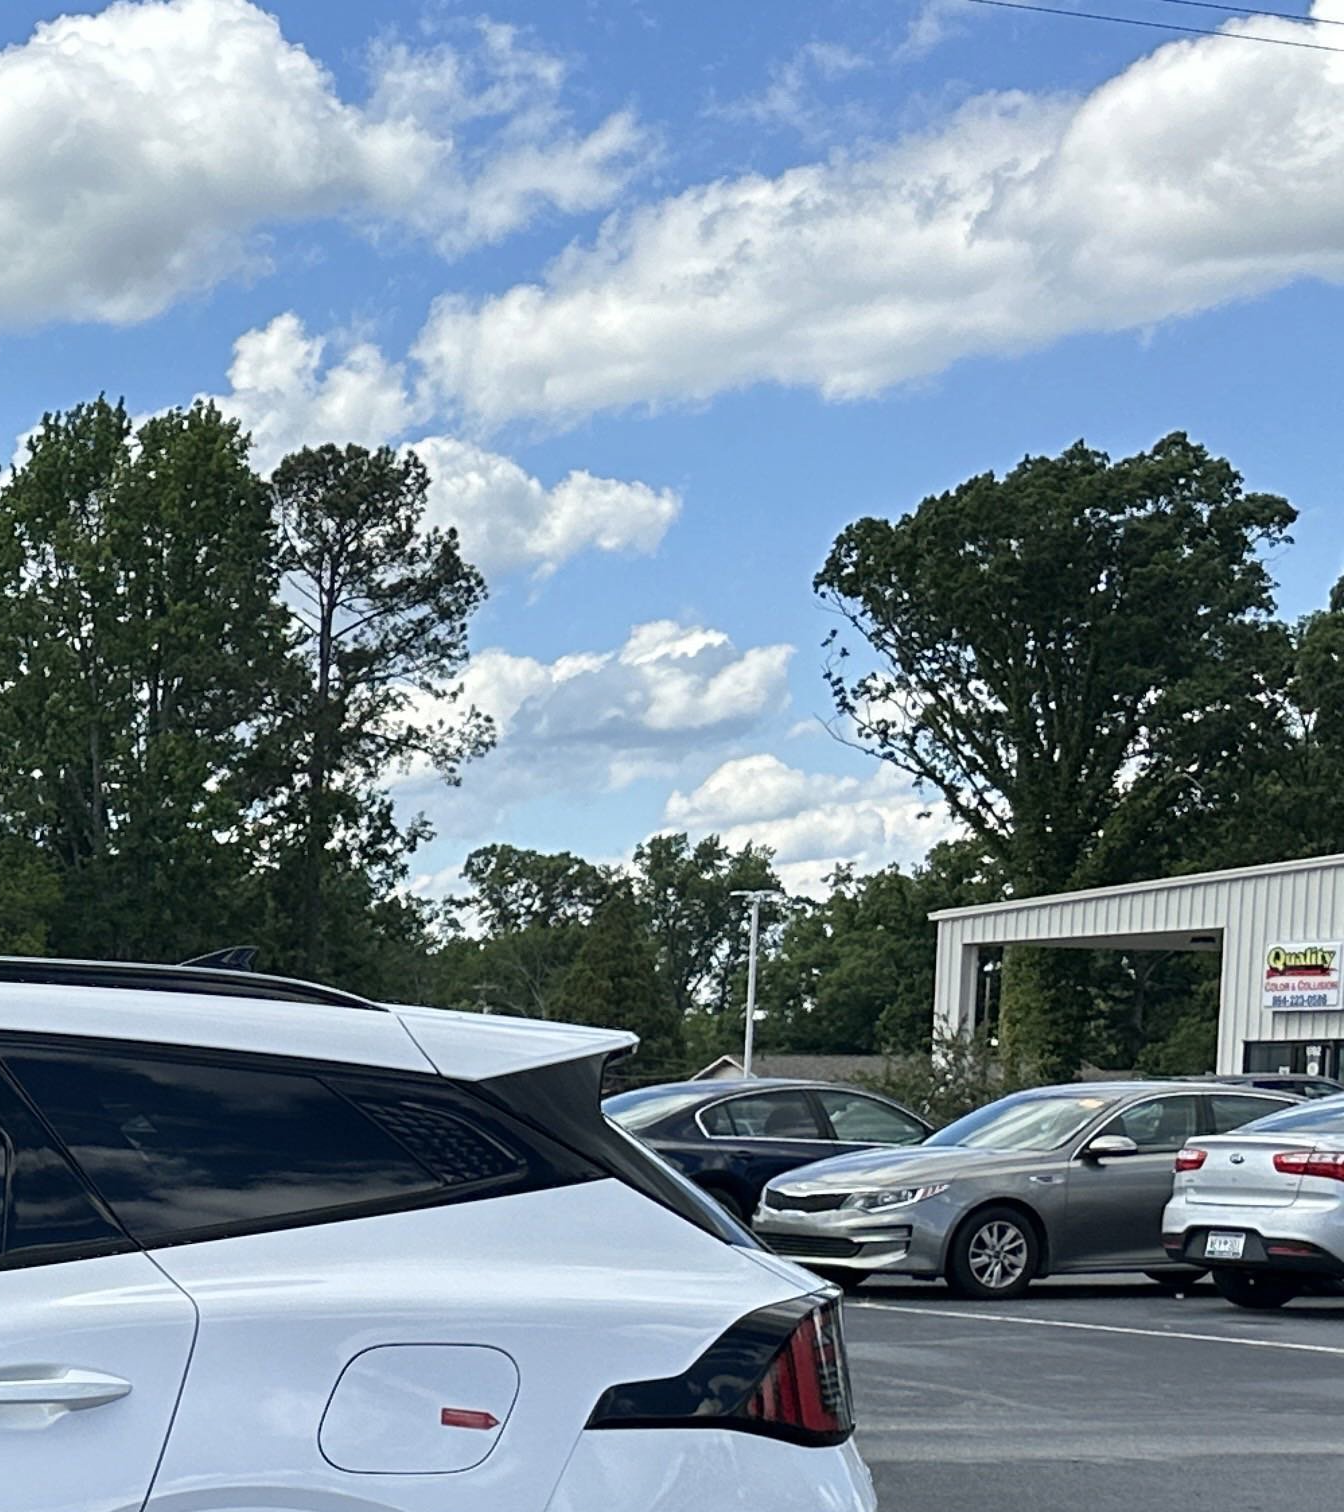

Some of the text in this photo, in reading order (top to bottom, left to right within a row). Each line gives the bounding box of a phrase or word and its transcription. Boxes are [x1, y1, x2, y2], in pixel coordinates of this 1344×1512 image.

[1267, 946, 1336, 972] Quality
[1264, 981, 1289, 993] COLOR
[1298, 979, 1338, 992] COLLISION
